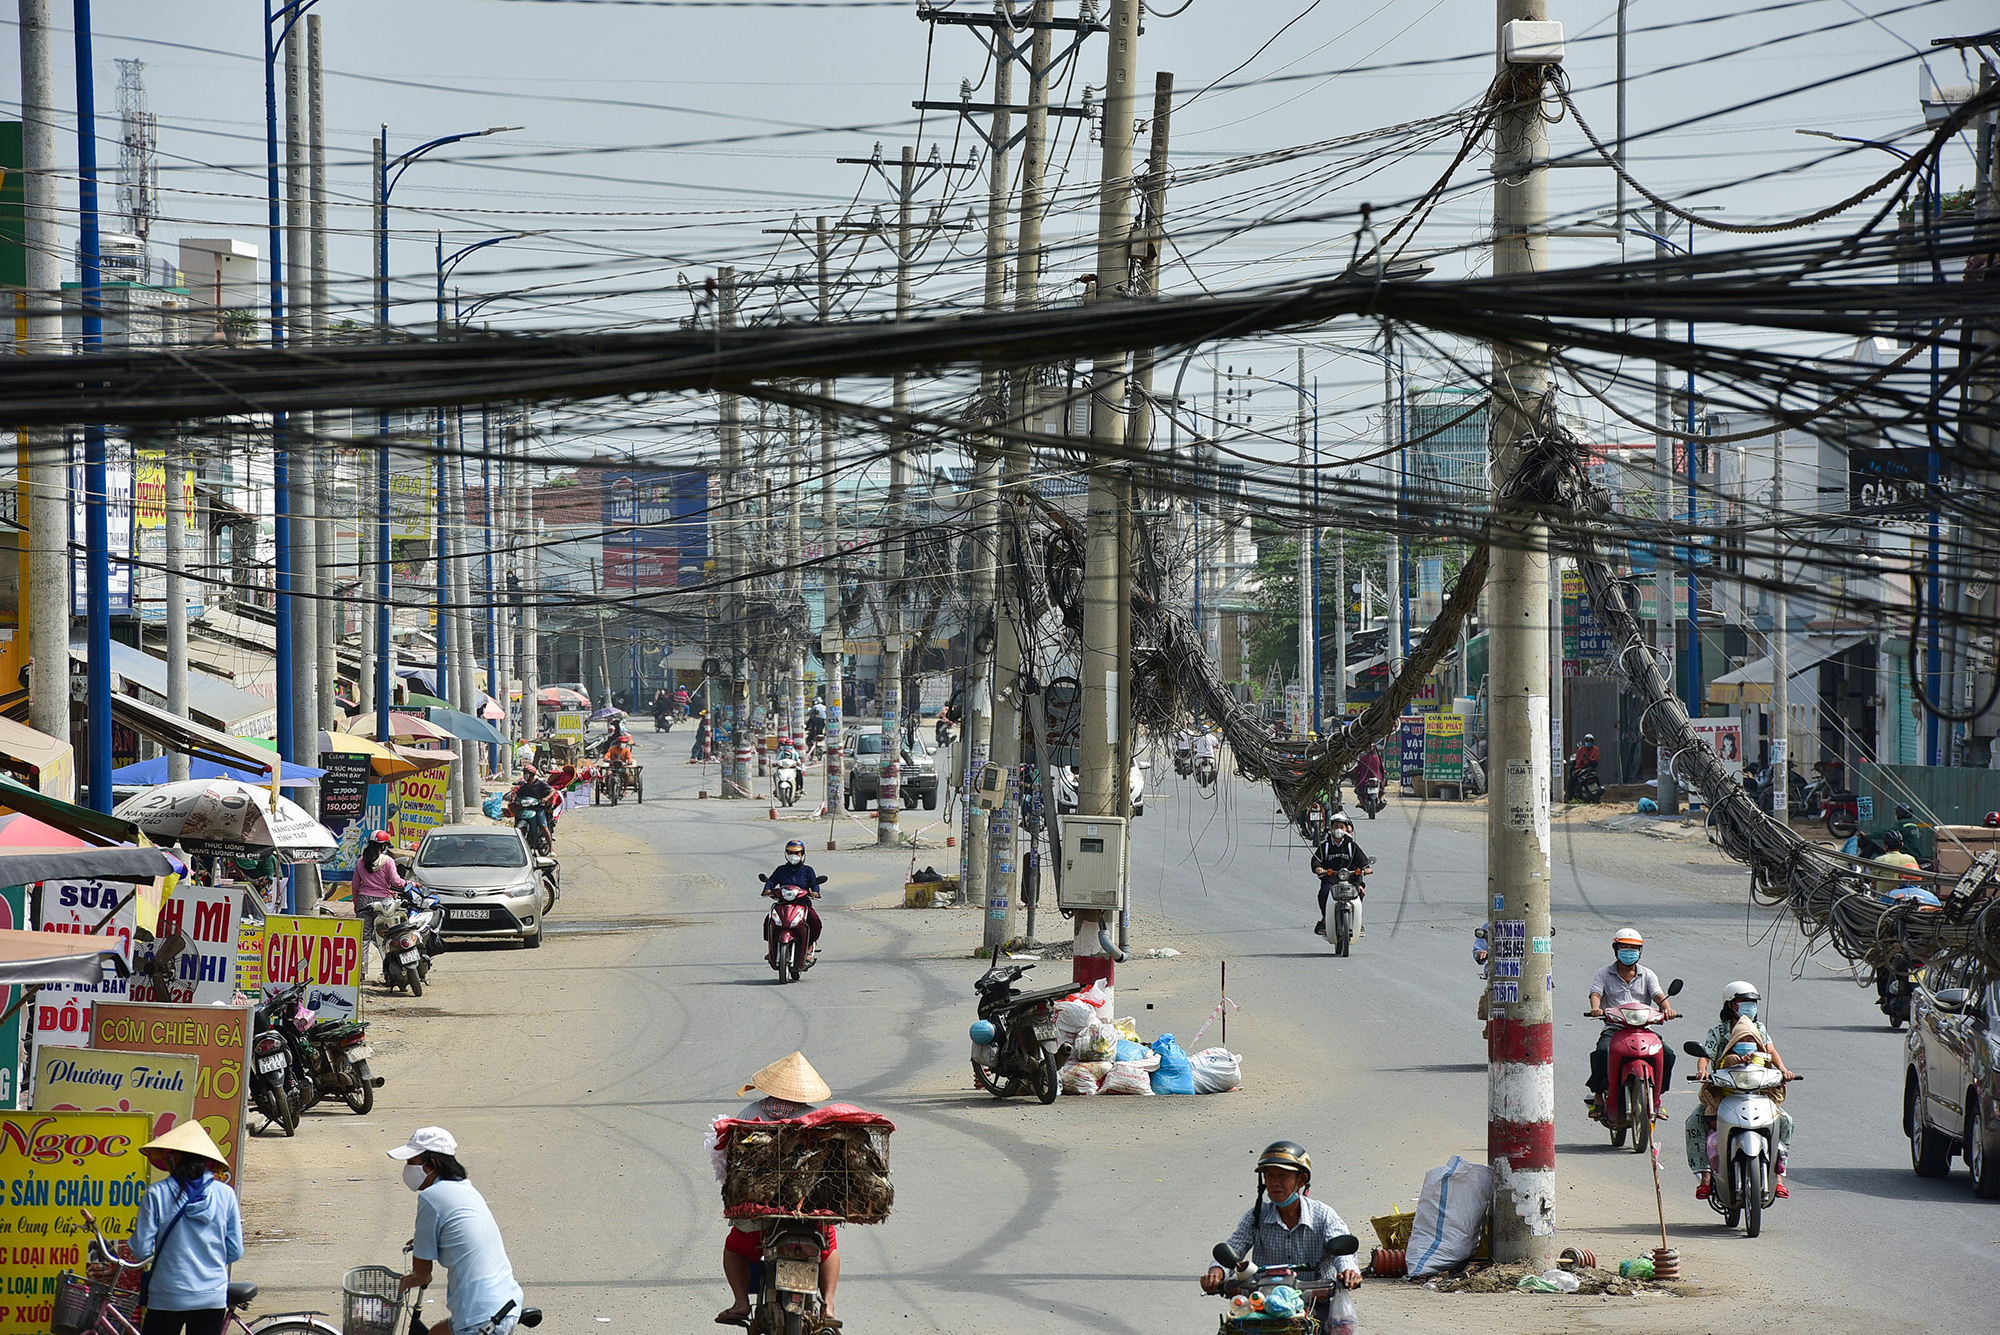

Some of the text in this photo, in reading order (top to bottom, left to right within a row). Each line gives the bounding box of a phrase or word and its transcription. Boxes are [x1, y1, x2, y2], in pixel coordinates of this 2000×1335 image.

[558, 714, 581, 729] NHA
[1427, 720, 1463, 730] HÙNG PHÁT
[1407, 738, 1423, 749] VẬT
[1427, 737, 1462, 750] VẬT LIỆU
[1403, 750, 1418, 760] XÂY
[1426, 753, 1462, 765] XÂY DỰNG
[347, 766, 366, 774] MẠNH
[141, 795, 176, 810] 2X
[59, 879, 119, 910] SỬA
[193, 896, 231, 943] MÌ
[266, 920, 358, 986] GIÀY DÉP
[180, 953, 227, 983] NHI
[102, 976, 127, 994] BÁN
[101, 1016, 146, 1044] CƠM
[150, 1017, 210, 1047] CHIÊN
[214, 1018, 244, 1048] GÀ
[46, 1058, 124, 1092] Phương
[0, 1116, 131, 1166] Ngọc
[11, 1169, 49, 1207] SẢN
[55, 1174, 103, 1207] CHÂU
[17, 1215, 49, 1237] Cung
[101, 1217, 121, 1234] Và
[12, 1248, 45, 1269] LOẠI
[50, 1244, 79, 1265] KHÔ
[7, 1277, 37, 1298] LOẠI
